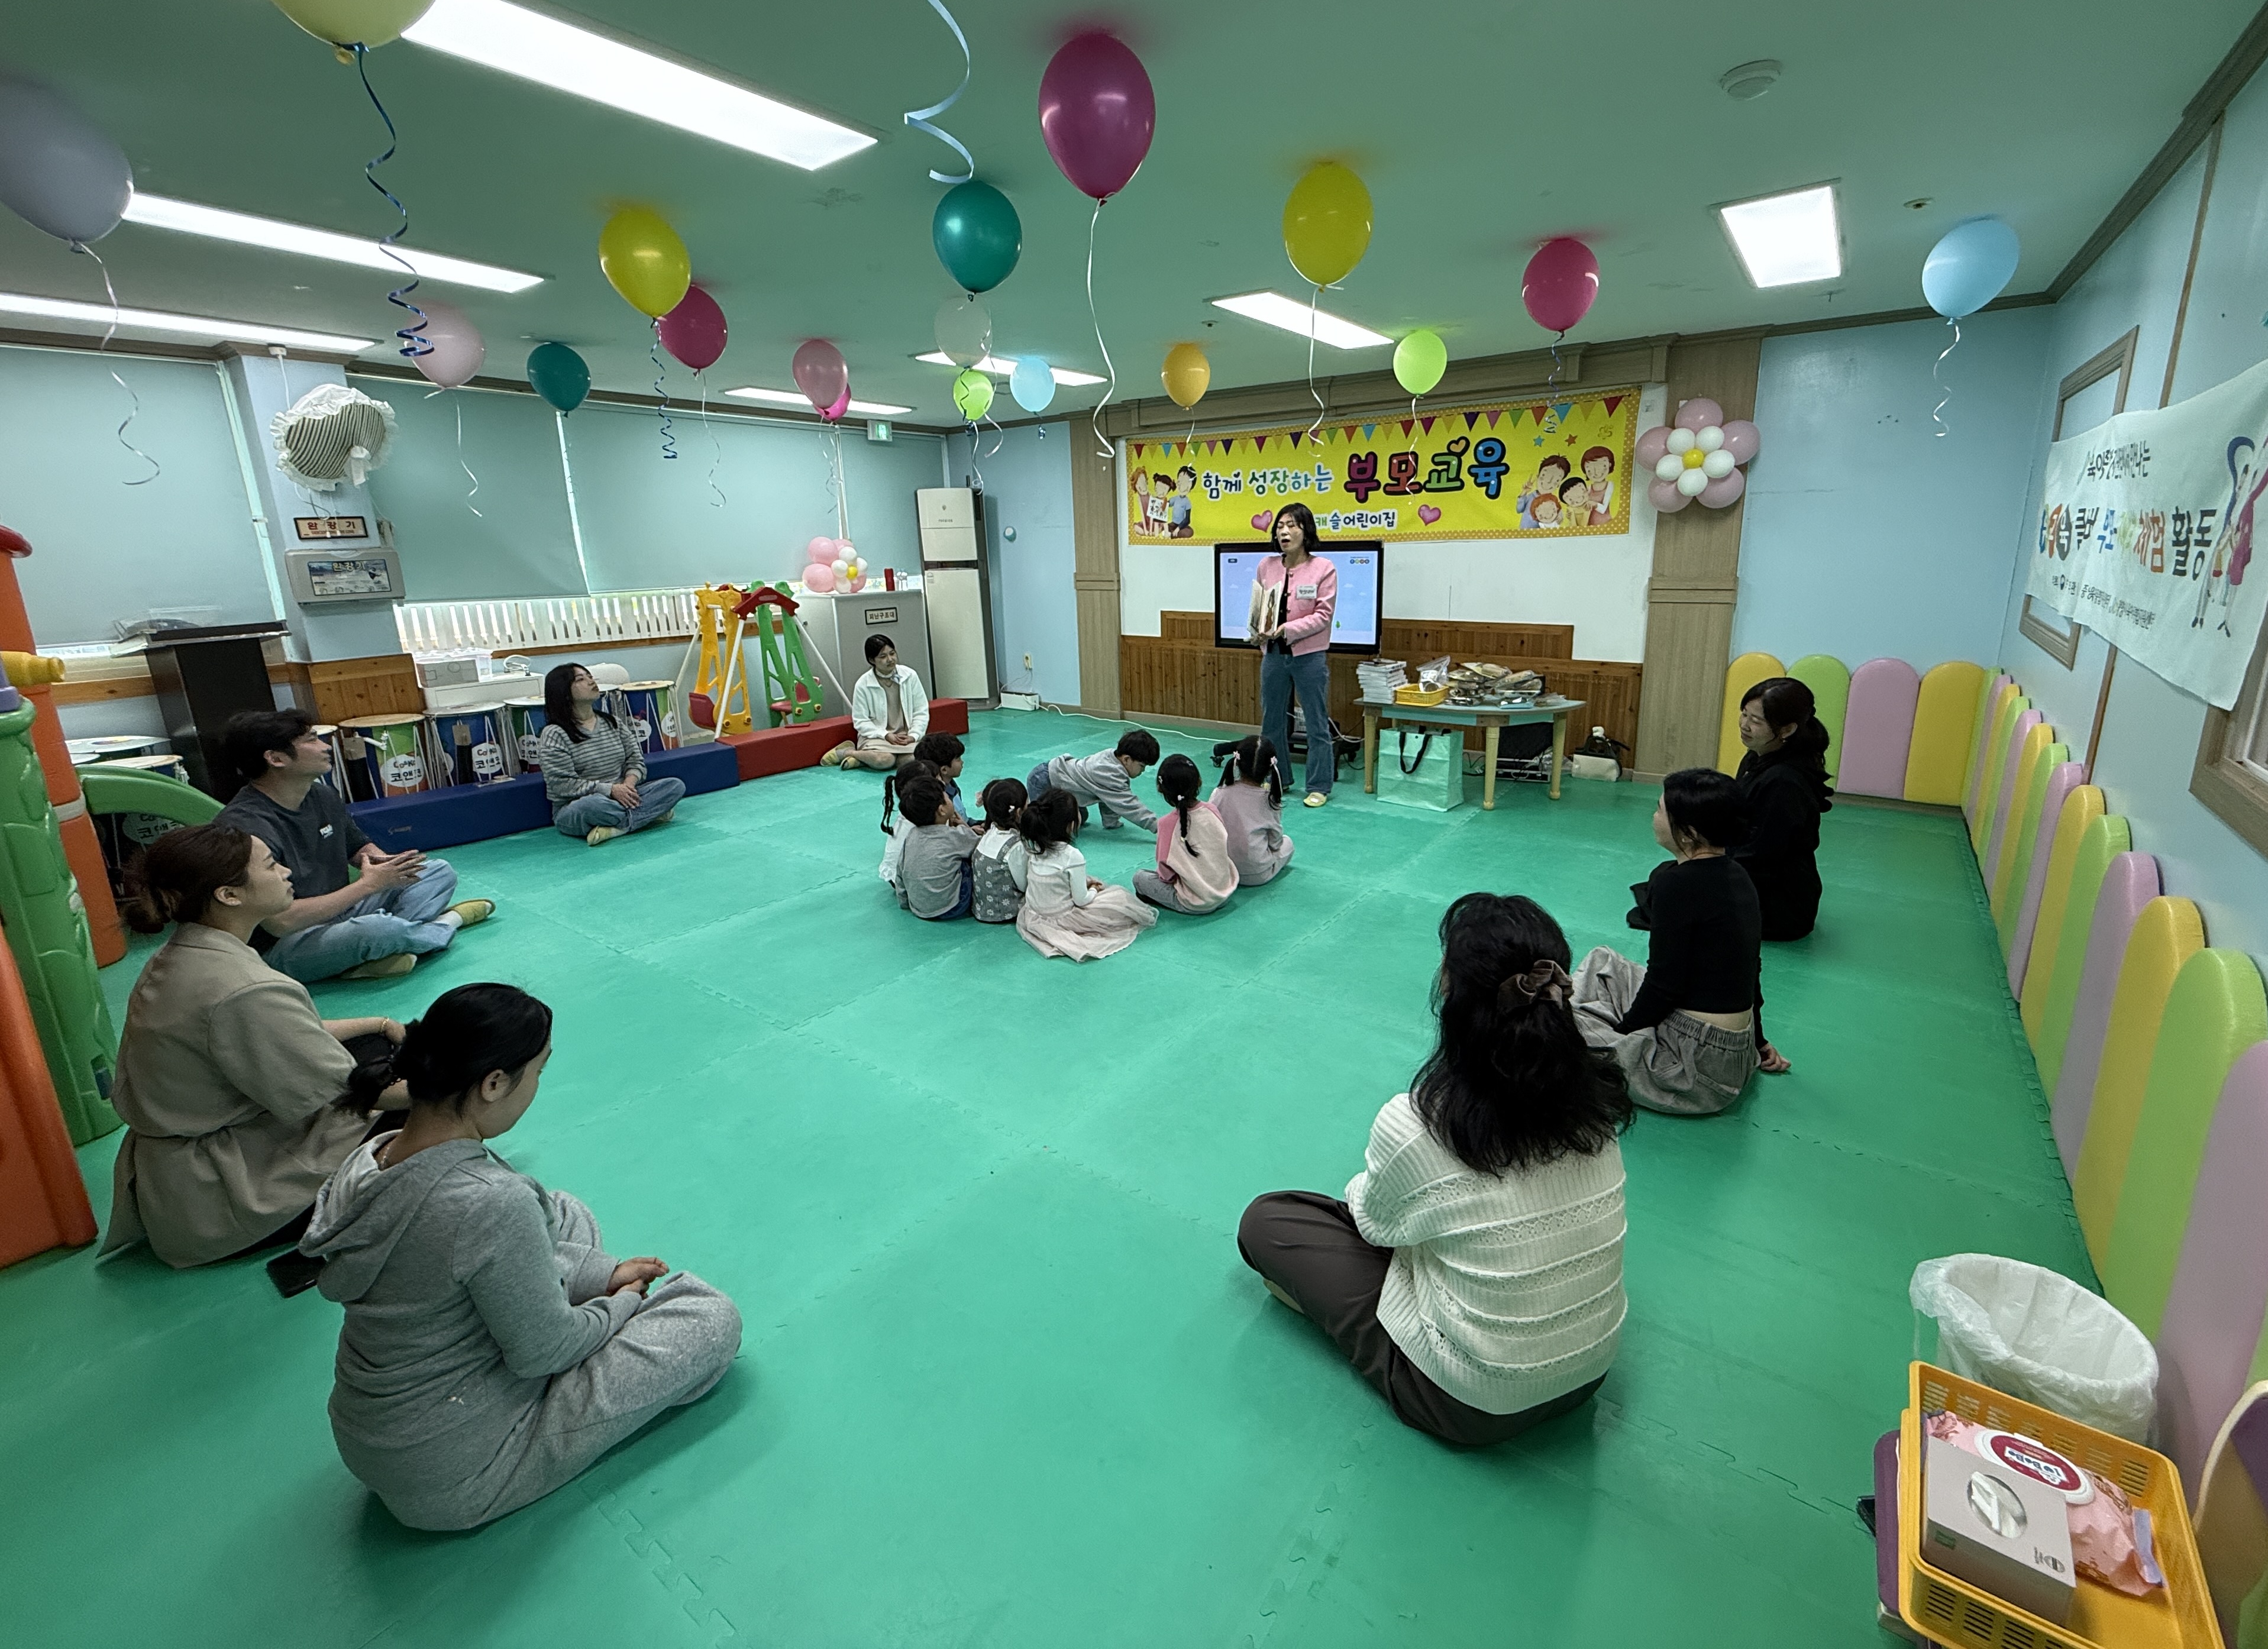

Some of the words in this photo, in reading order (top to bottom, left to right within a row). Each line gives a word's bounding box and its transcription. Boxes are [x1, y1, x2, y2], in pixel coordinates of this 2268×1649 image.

[1203, 471, 1242, 499] 함께
[1249, 464, 1332, 495] 성장하는
[1343, 436, 1510, 504] 부모교육
[2172, 506, 2217, 581] 활동
[869, 612, 894, 620] 피난구조대
[390, 768, 422, 782] 코앤코
